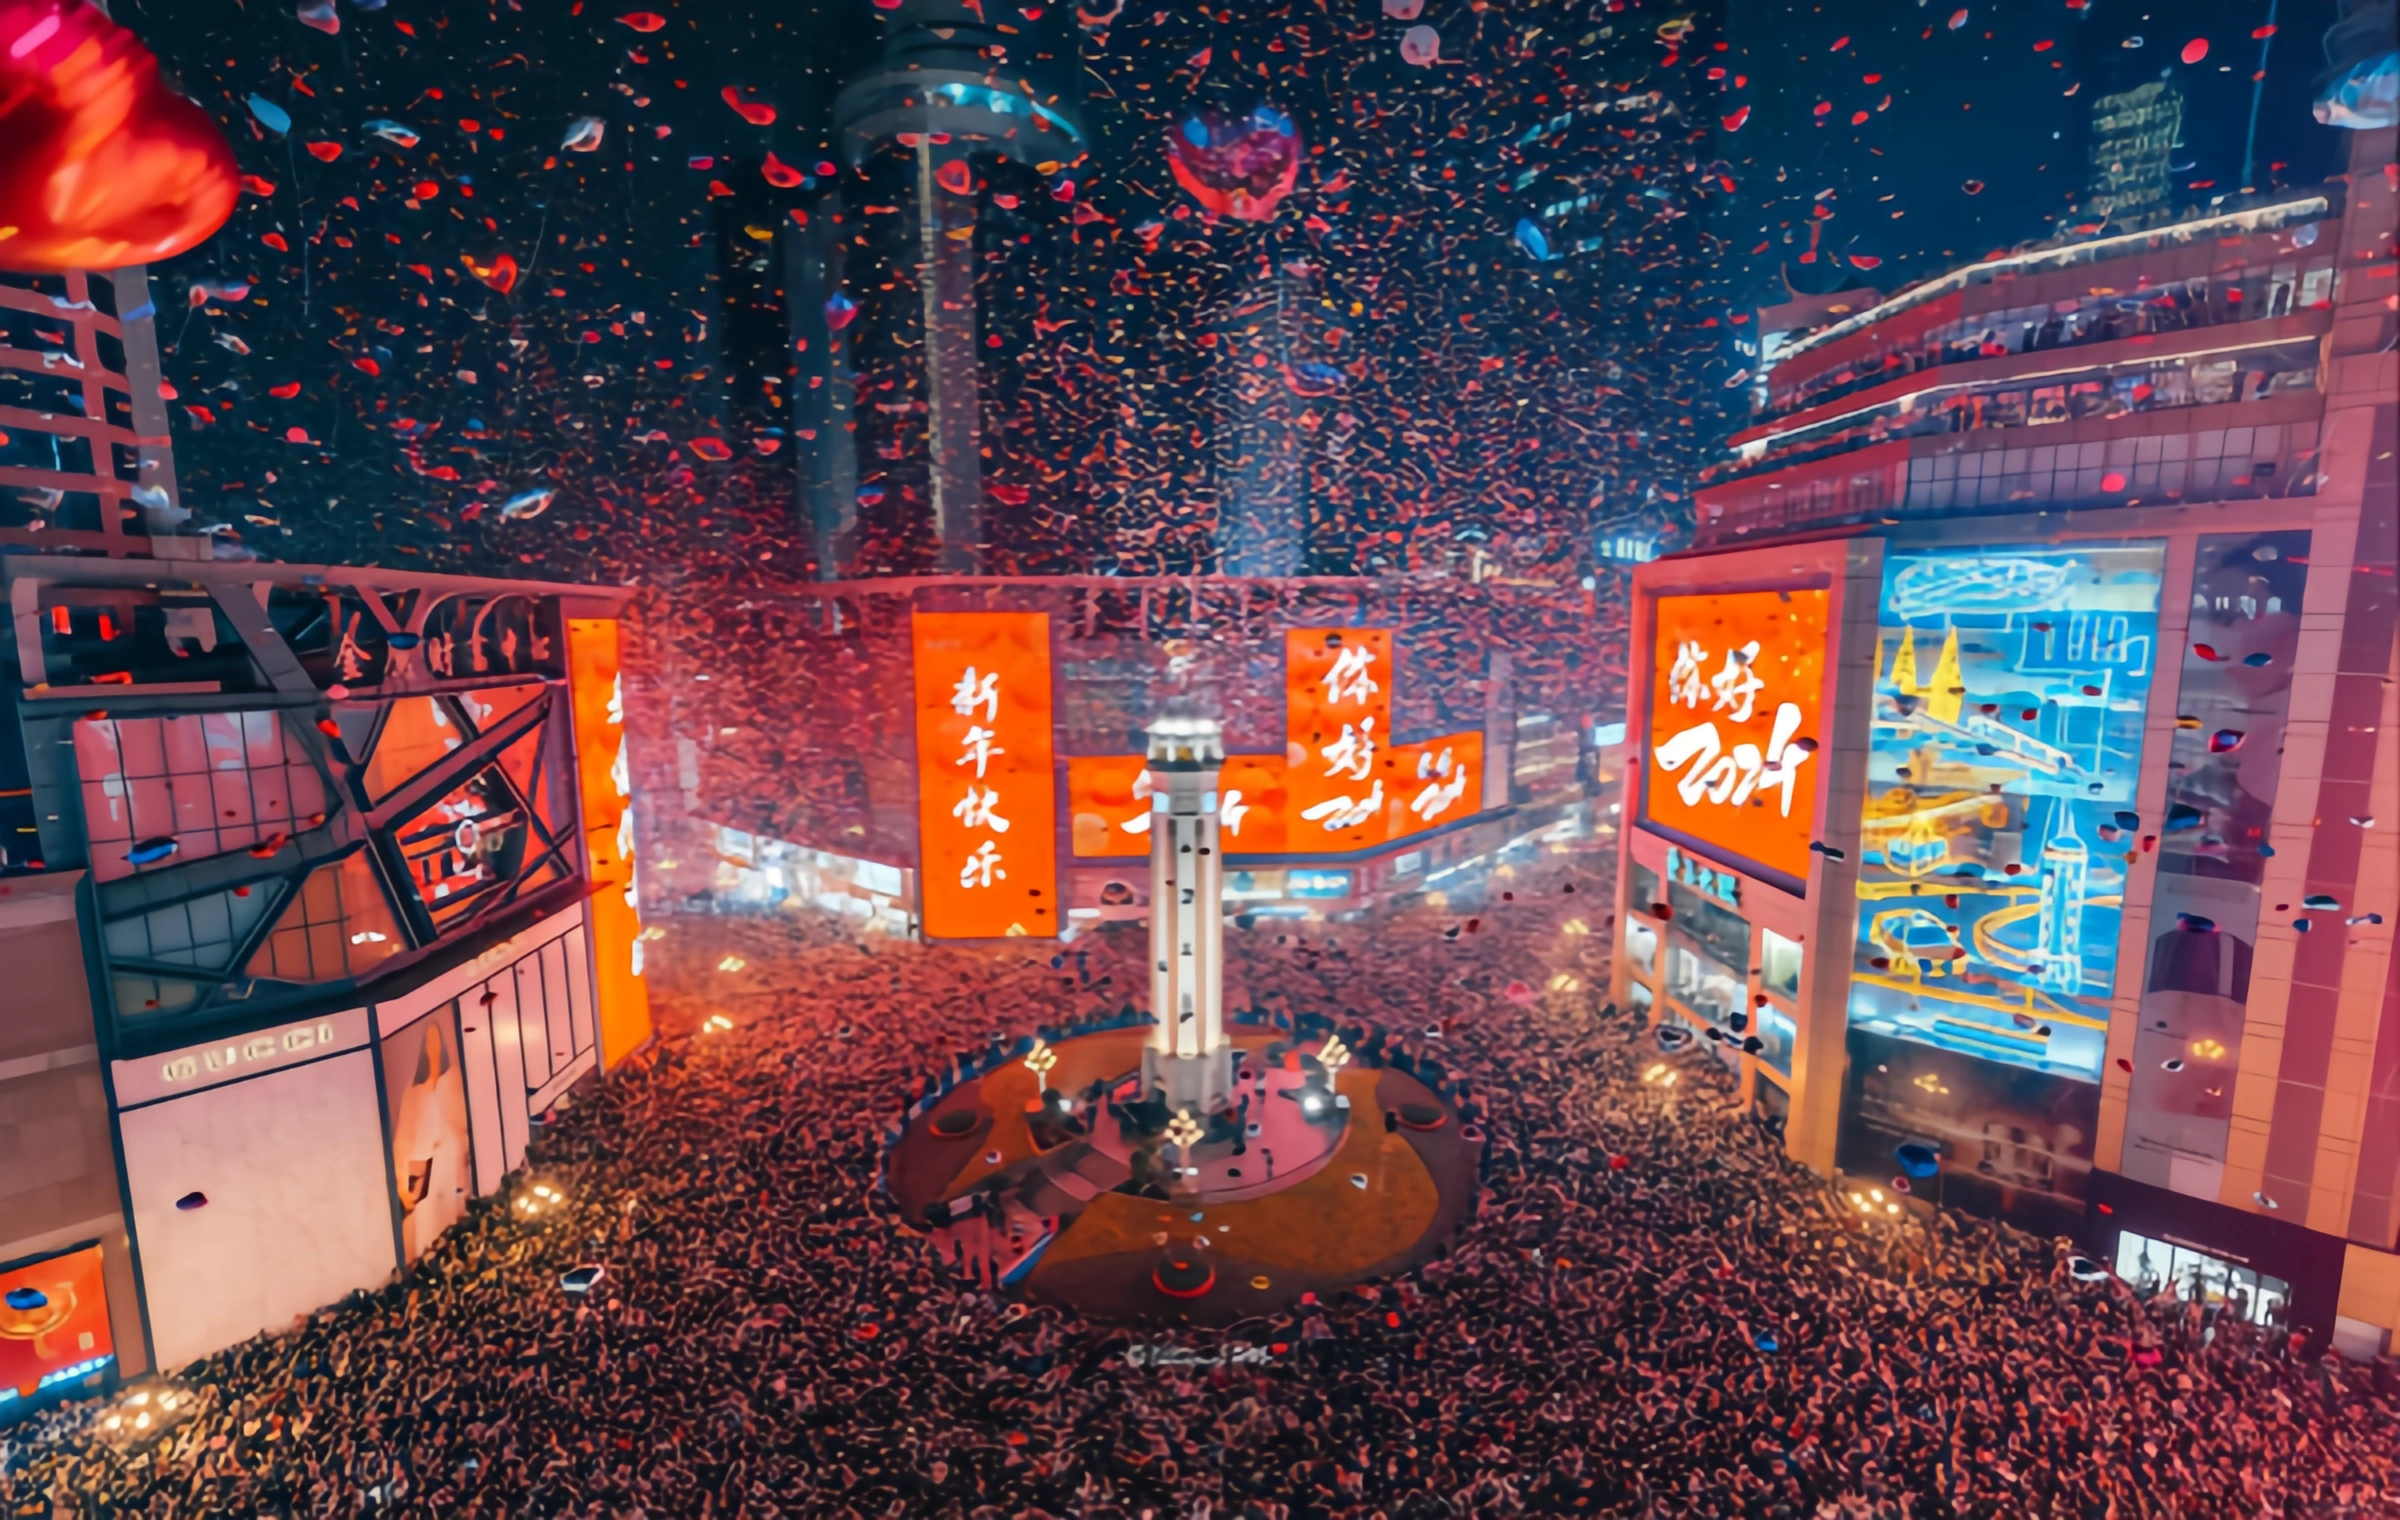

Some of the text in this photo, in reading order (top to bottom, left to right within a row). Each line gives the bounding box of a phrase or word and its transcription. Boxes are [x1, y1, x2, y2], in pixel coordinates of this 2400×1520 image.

[1670, 640, 1765, 722] 你好
[951, 665, 1010, 889] 新年快乐
[1655, 702, 1811, 818] 2024
[162, 1023, 334, 1082] GUCCI
